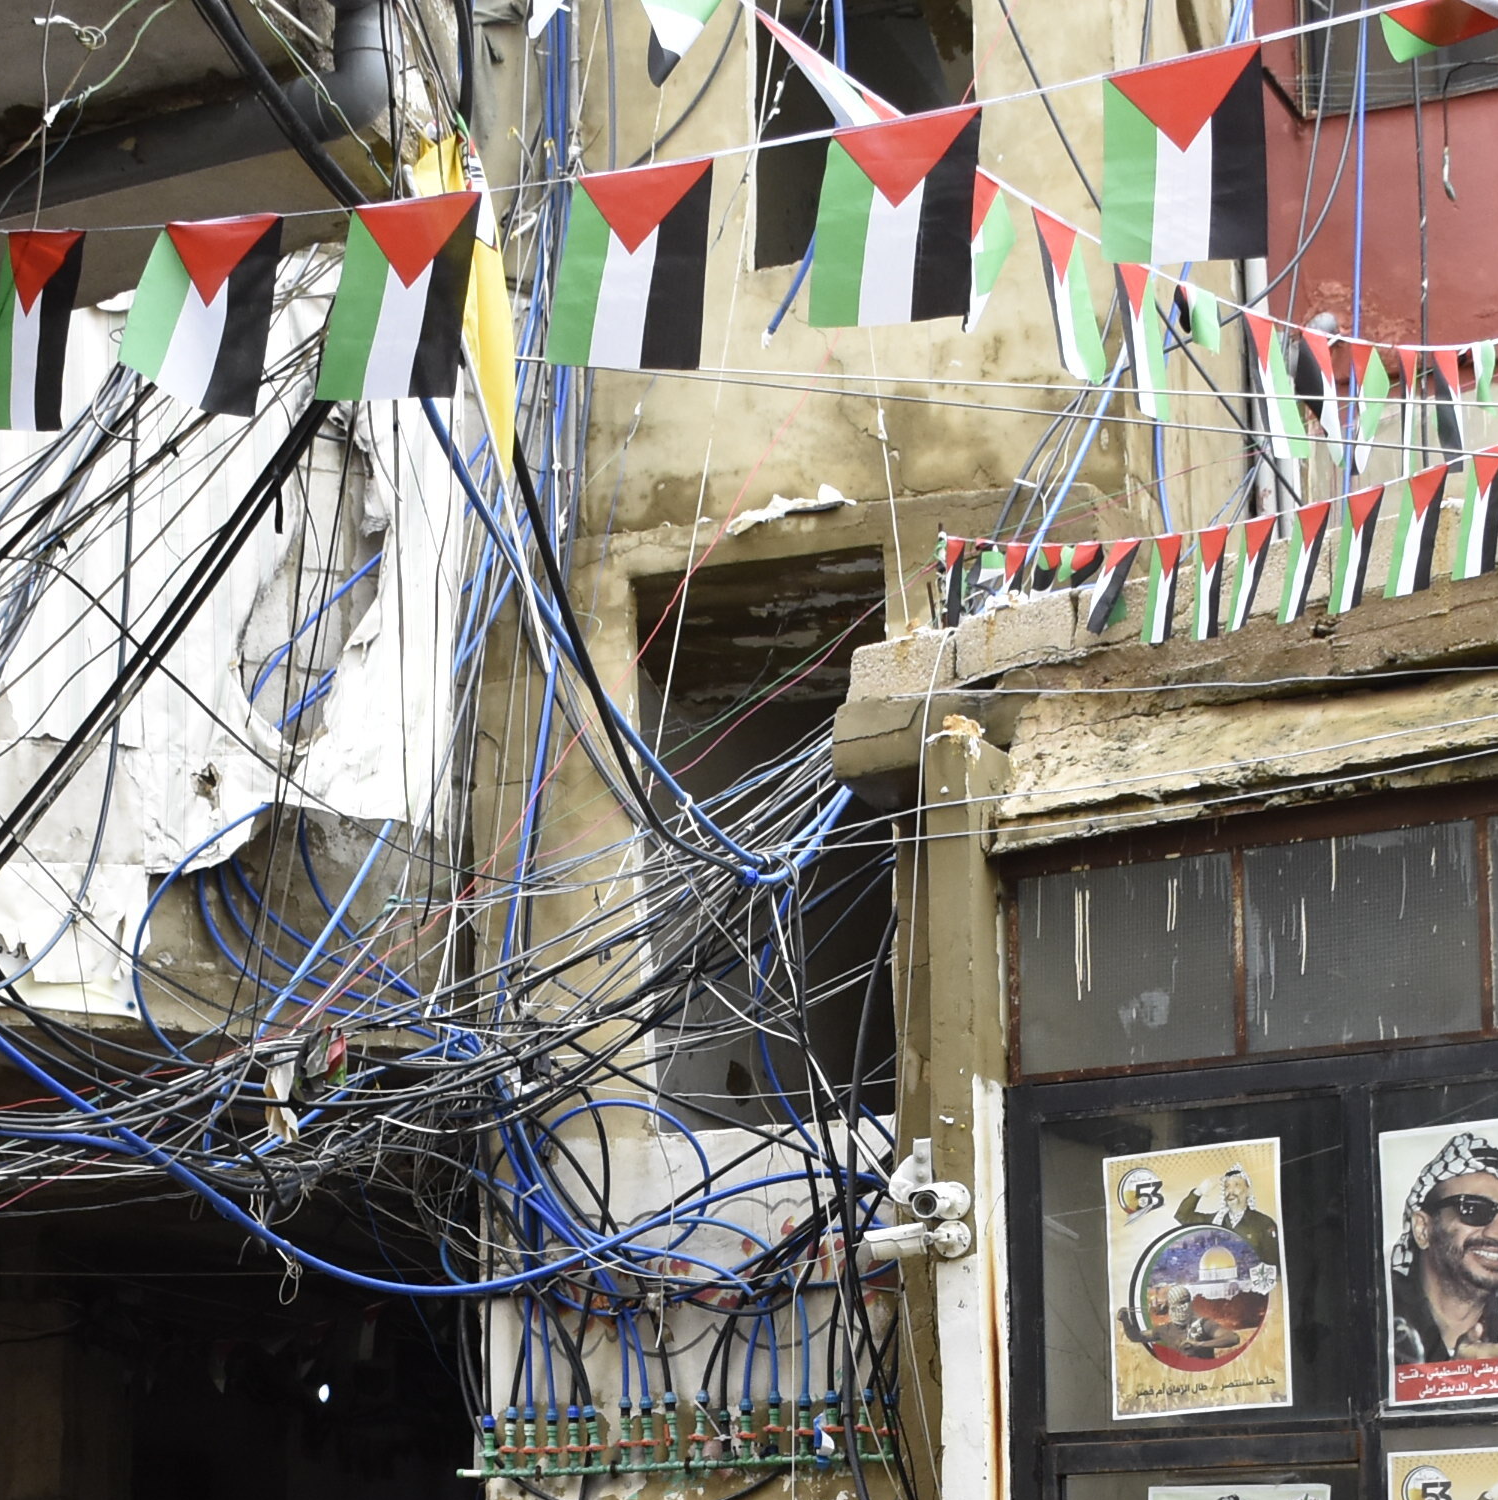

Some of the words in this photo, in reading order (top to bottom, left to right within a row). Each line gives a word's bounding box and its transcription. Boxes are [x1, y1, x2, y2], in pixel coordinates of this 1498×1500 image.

[1135, 1181, 1165, 1211] 53
[1398, 1368, 1419, 1382] فتح
[1426, 1365, 1472, 1380] الفلسطيني
[1419, 1382, 1468, 1398] الديمقراطي
